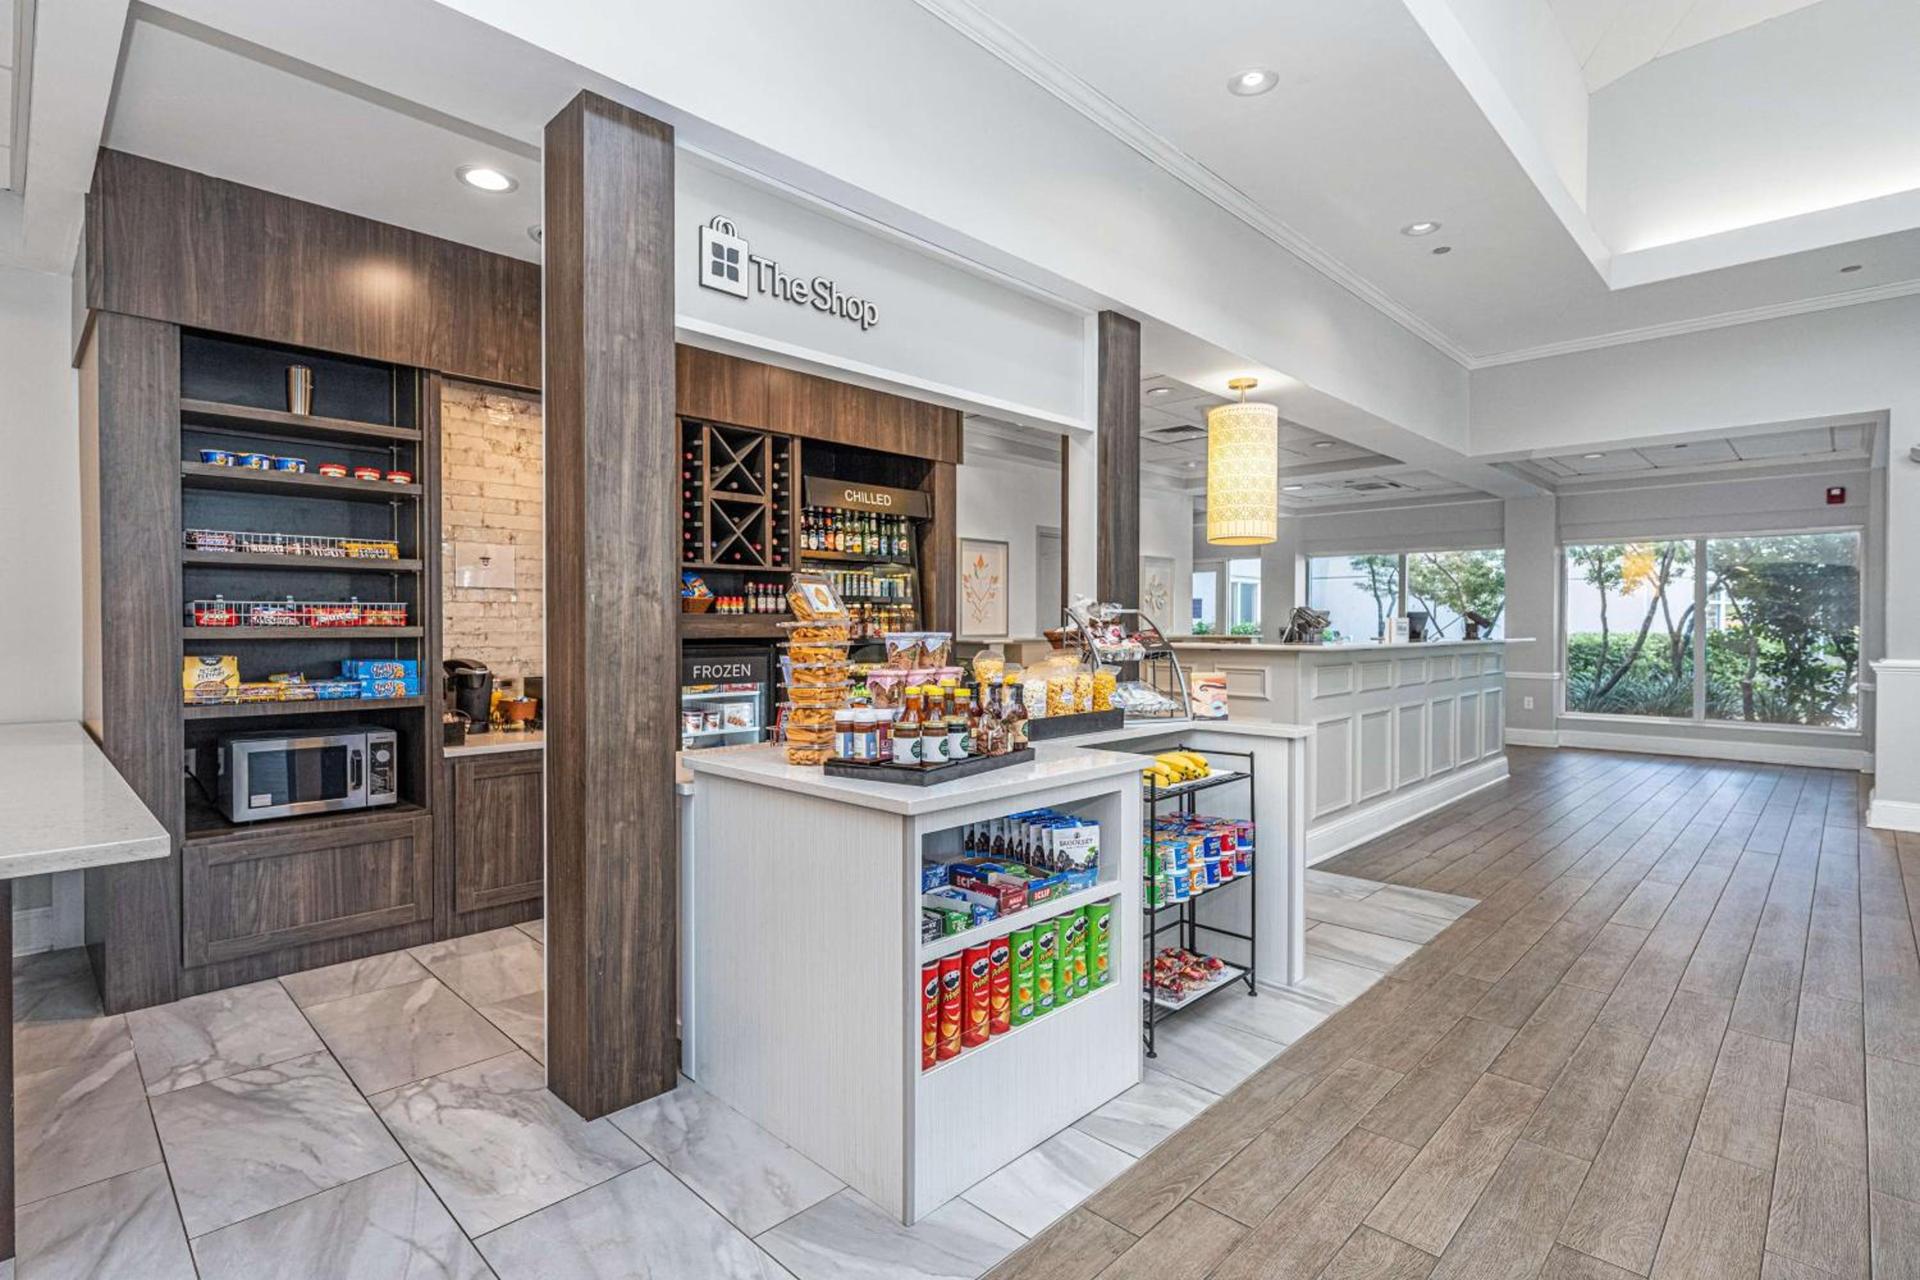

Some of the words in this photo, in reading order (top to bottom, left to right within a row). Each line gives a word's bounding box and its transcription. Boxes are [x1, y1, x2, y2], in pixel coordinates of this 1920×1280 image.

[749, 254, 808, 304] The
[811, 276, 879, 331] Shop
[844, 489, 892, 507] CHILLED
[692, 663, 751, 679] FROZEN
